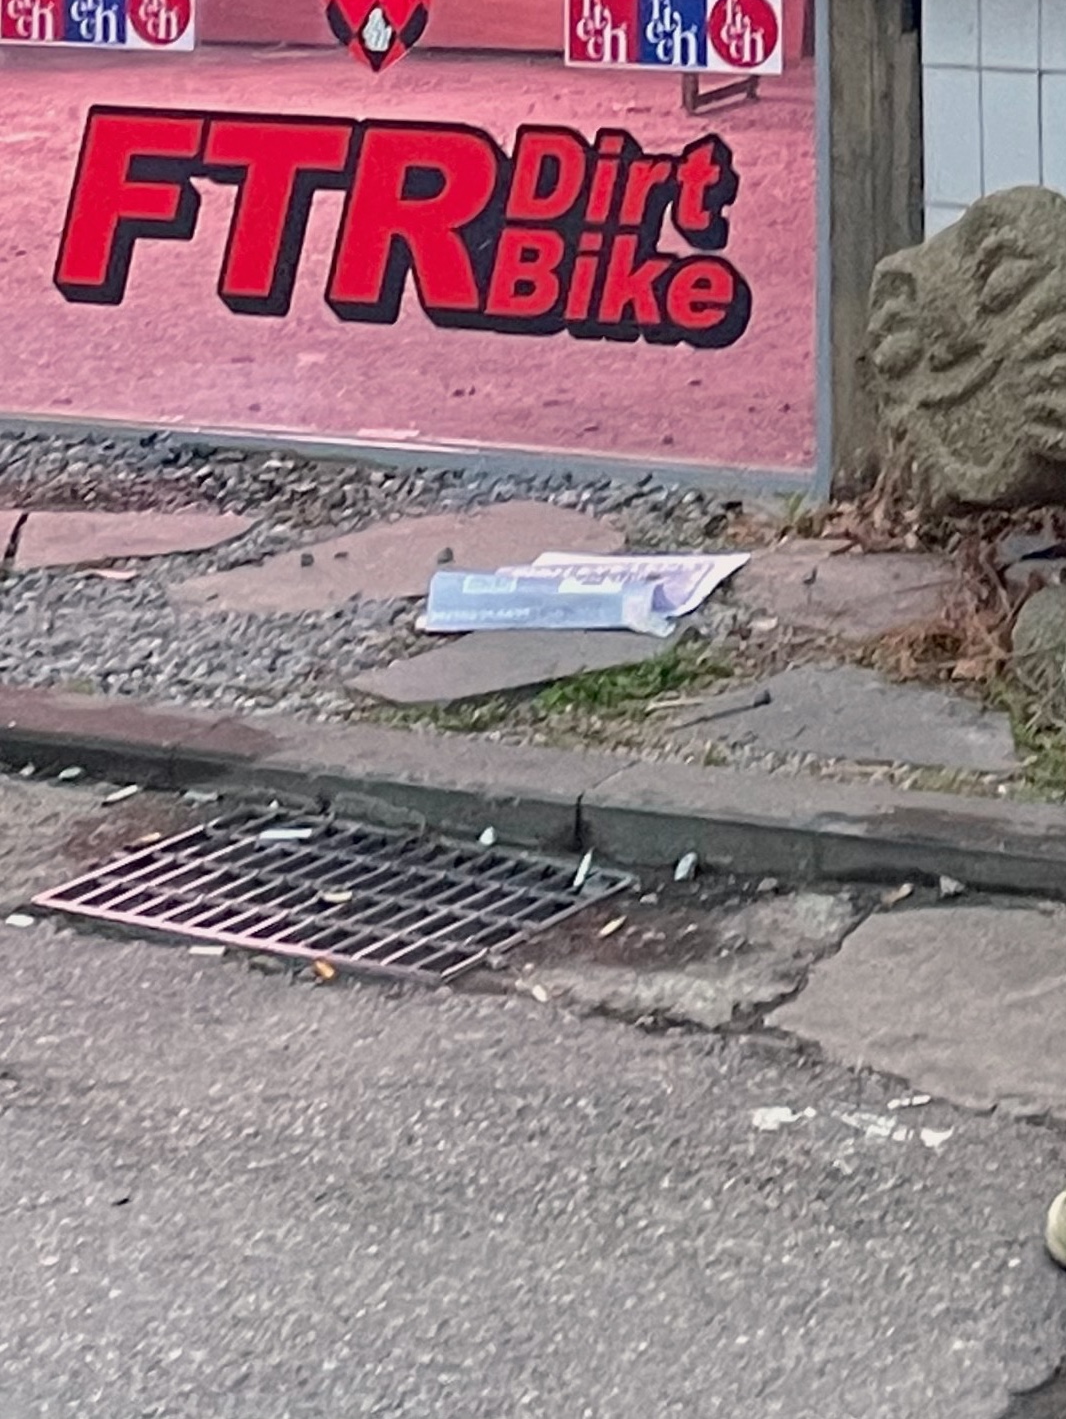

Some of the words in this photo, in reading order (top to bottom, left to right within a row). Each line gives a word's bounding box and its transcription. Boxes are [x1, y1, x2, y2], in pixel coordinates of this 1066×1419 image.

[53, 105, 505, 332] FTR
[504, 122, 739, 248] Dirt
[484, 228, 752, 350] Bike
